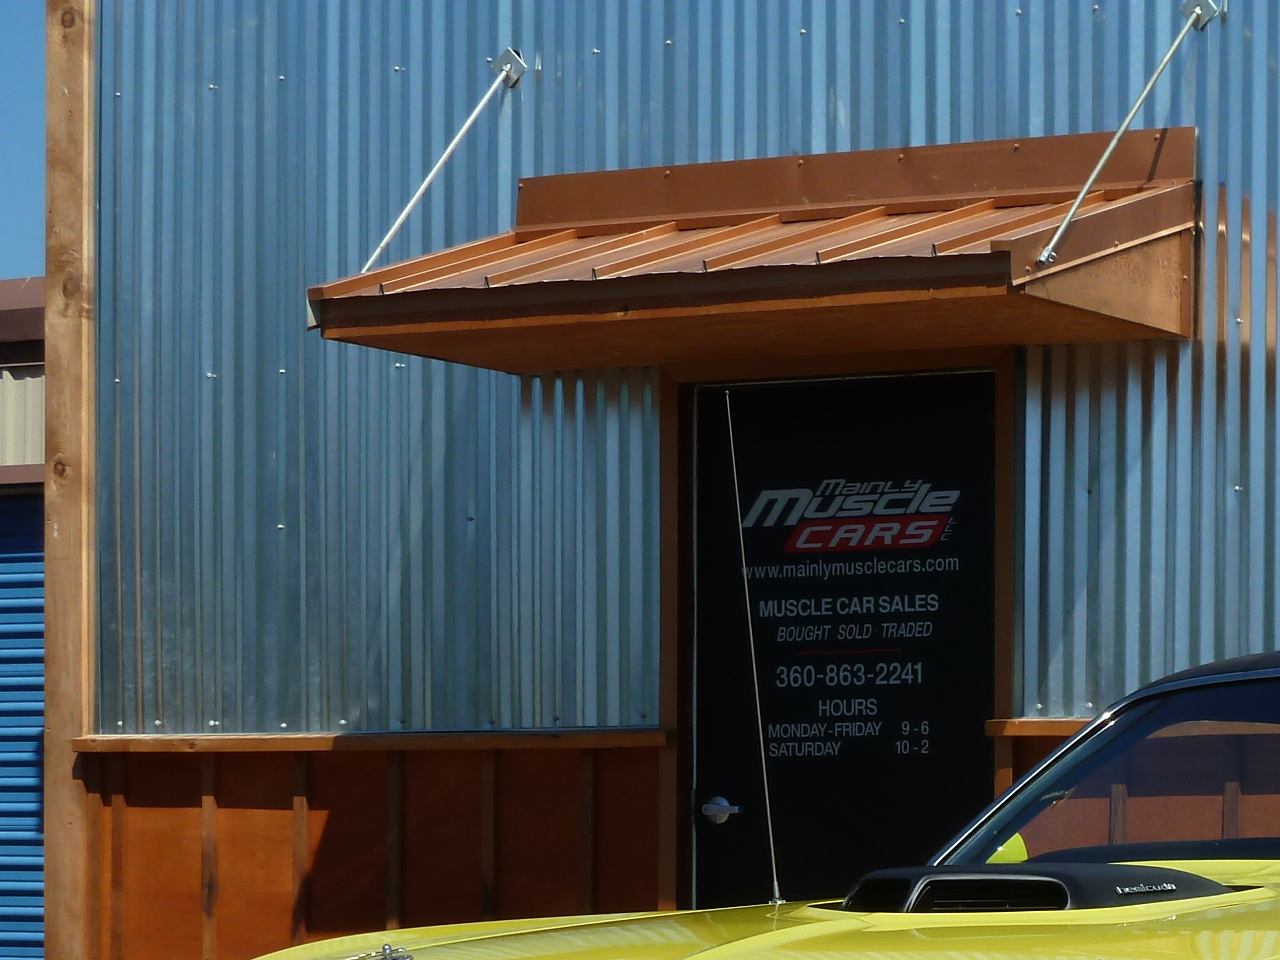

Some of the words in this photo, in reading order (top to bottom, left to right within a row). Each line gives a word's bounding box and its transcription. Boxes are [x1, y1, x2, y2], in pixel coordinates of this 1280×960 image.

[795, 521, 938, 549] CARS
[741, 556, 959, 581] www.mainlymusclecars.com
[759, 598, 832, 618] MUSCLE
[836, 596, 874, 615] CAR
[878, 594, 939, 613] SALES
[777, 624, 832, 642] BOUGHT
[837, 623, 872, 640] SOLD
[881, 621, 933, 638] TRADED
[775, 662, 923, 688] 360-863-2241
[818, 698, 878, 717] HOURS
[768, 741, 841, 757] SATURDAY
